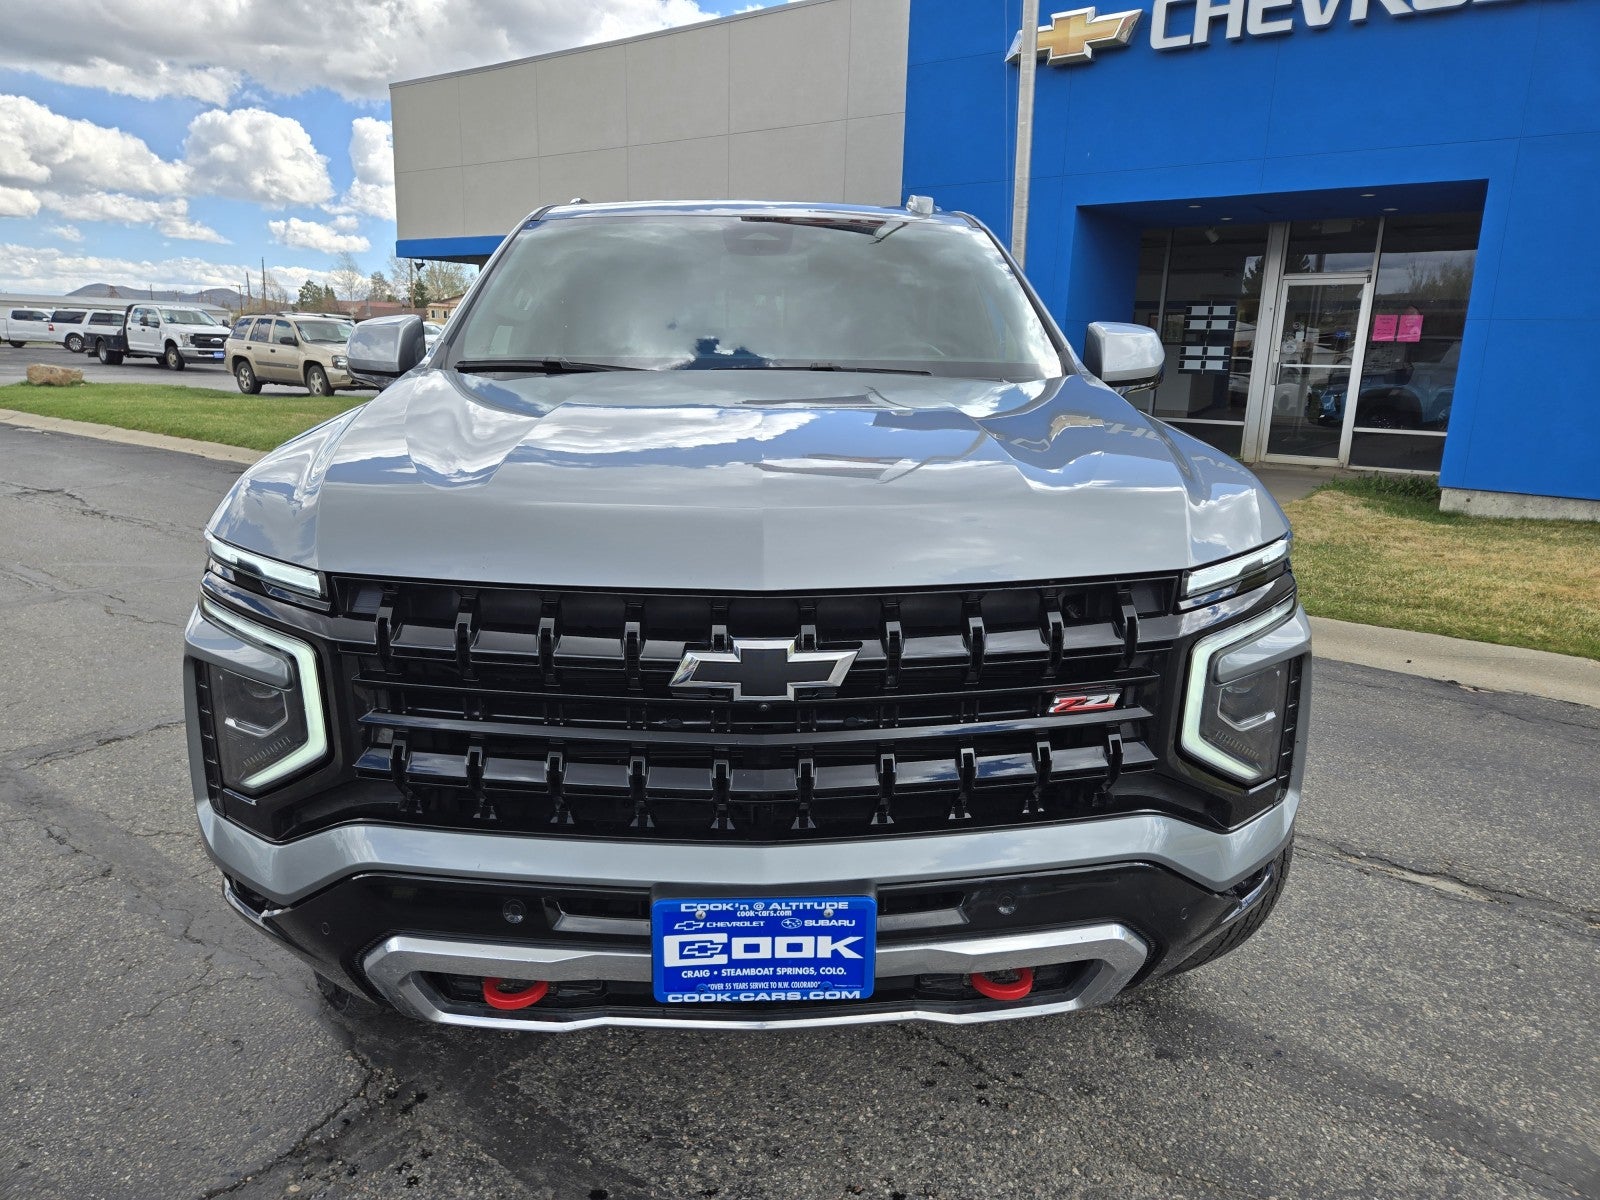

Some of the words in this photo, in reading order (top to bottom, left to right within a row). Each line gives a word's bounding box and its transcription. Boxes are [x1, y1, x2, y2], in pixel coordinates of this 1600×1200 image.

[1048, 693, 1120, 713] Z71
[680, 903, 749, 912] COOK'n
[753, 901, 765, 911] @
[769, 901, 849, 910] ALTITUDE
[706, 920, 766, 928] CHEVROLET
[804, 919, 856, 927] SUBARU
[663, 932, 864, 967] COOK
[681, 969, 710, 978] CRAIG
[721, 967, 774, 977] STEAMBOAT
[776, 967, 818, 976] SPRINGS,
[820, 967, 847, 975] COLO.
[725, 982, 732, 990] 55
[733, 982, 749, 990] YEARS
[749, 981, 769, 989] SERVICE
[770, 981, 777, 989] TO
[777, 981, 790, 989] N.W.
[667, 990, 861, 1003] COOK-CARS.COM
